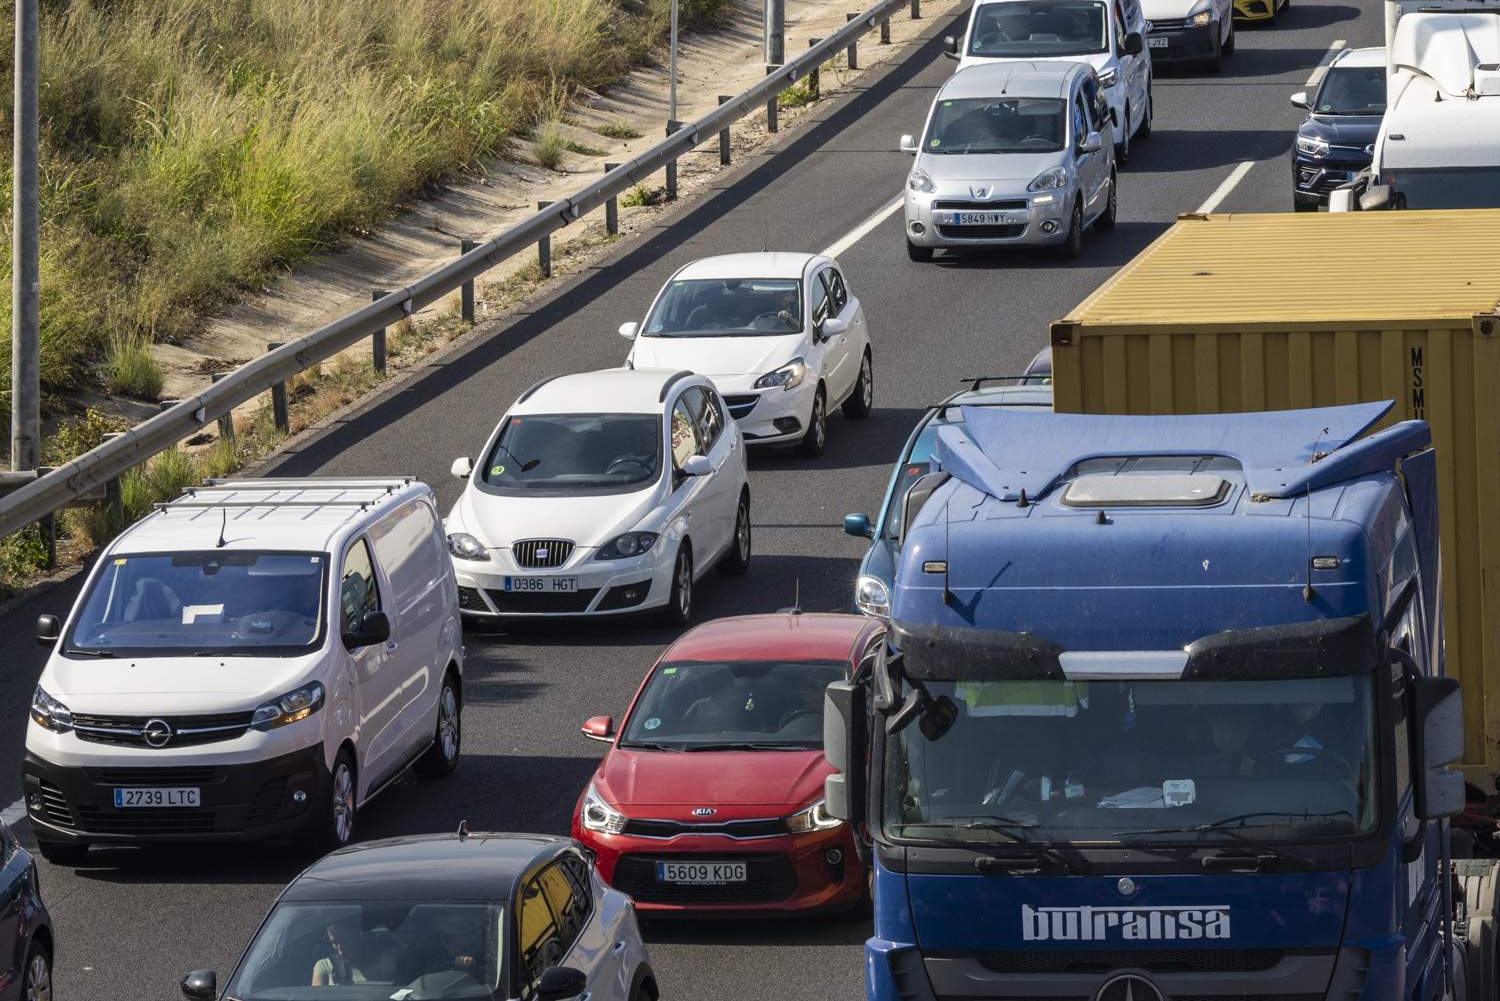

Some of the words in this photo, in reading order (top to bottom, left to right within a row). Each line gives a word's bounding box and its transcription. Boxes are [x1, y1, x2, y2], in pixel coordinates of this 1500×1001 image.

[961, 214, 985, 224] 5849
[514, 578, 544, 591] 0386
[552, 578, 576, 591] HGT
[126, 790, 163, 805] 2739
[168, 790, 196, 805] LTC
[667, 865, 708, 880] 5609
[713, 865, 744, 880] KDG
[1021, 904, 1231, 941] butransa
